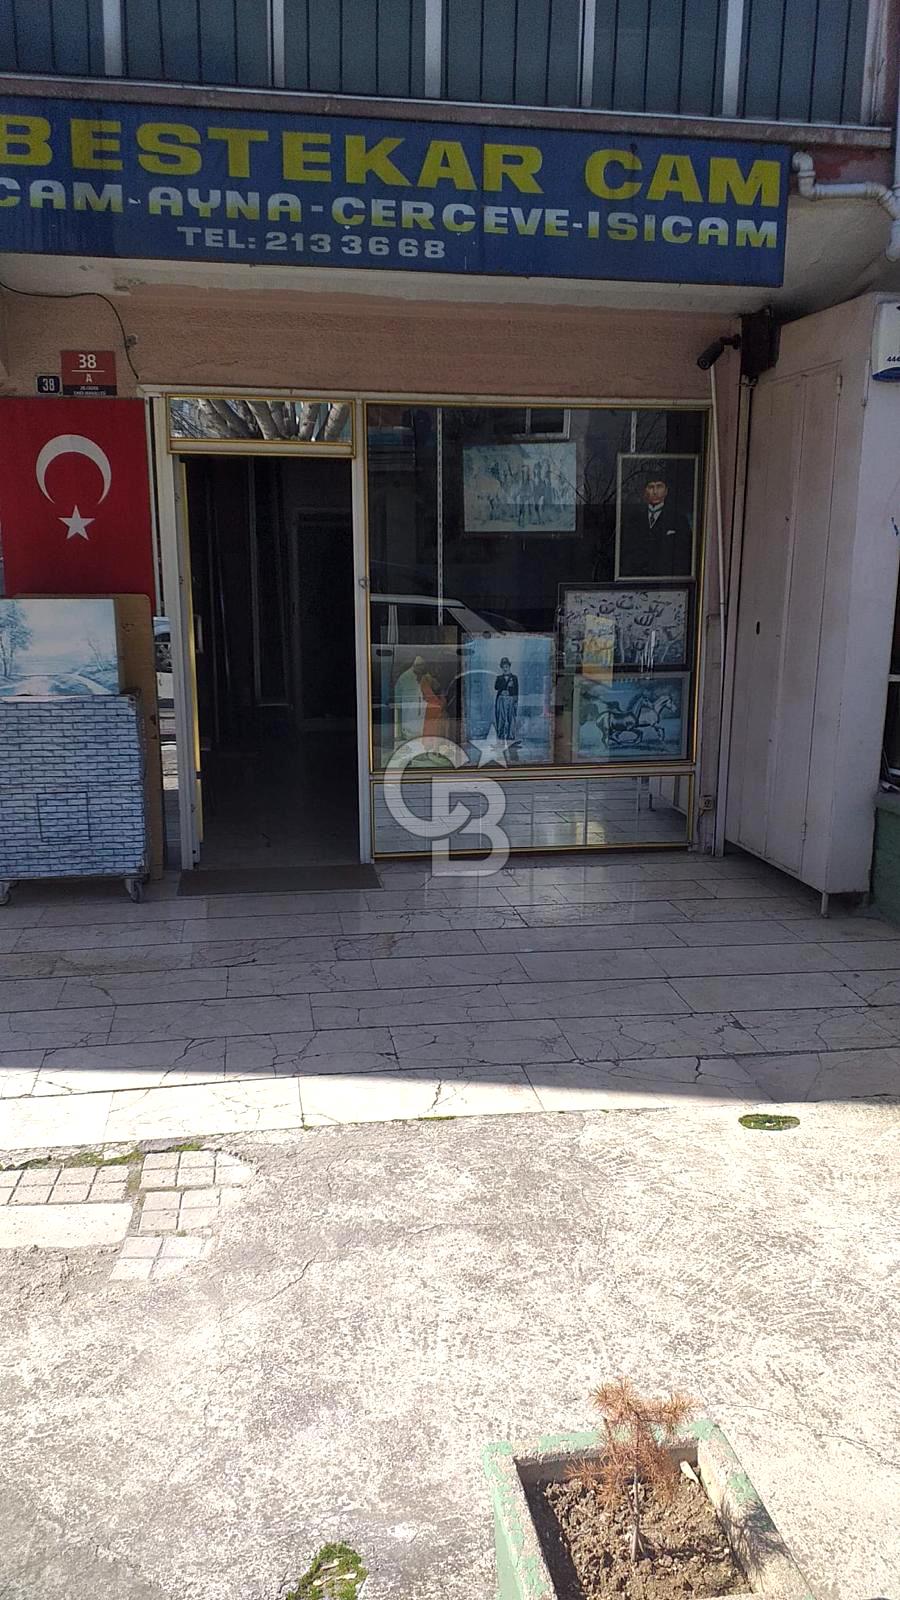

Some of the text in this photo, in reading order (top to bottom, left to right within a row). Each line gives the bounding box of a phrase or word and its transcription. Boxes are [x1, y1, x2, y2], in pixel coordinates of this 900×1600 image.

[0, 114, 781, 208] BESTEKAR CAM
[177, 226, 256, 249] TEL:
[78, 354, 97, 369] 38
[42, 378, 55, 391] 38
